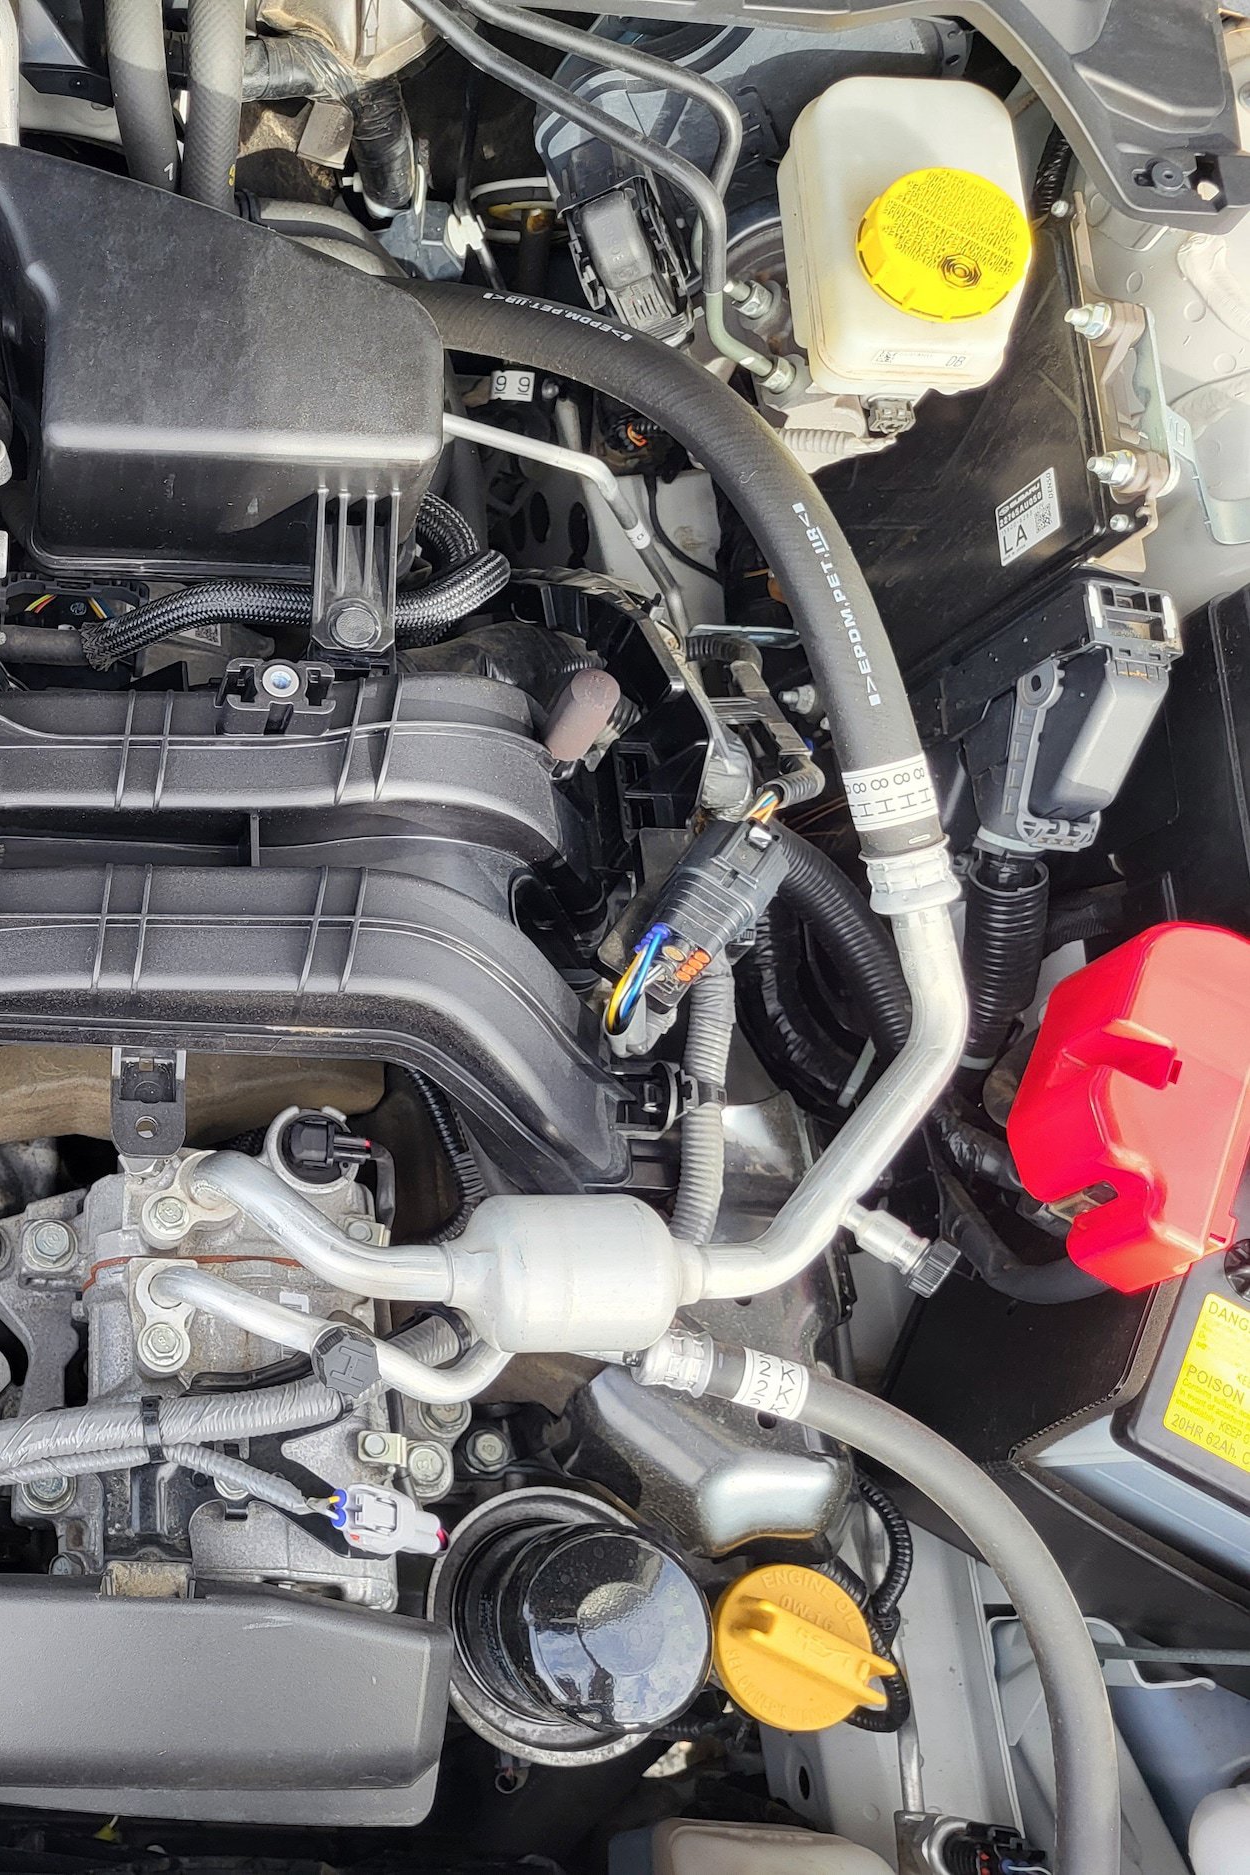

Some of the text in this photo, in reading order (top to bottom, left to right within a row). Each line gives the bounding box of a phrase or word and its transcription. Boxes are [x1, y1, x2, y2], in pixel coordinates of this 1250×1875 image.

[1209, 1301, 1250, 1334] DANG
[1185, 1364, 1245, 1406] POISON
[761, 1569, 860, 1633] ENGINE OIL
